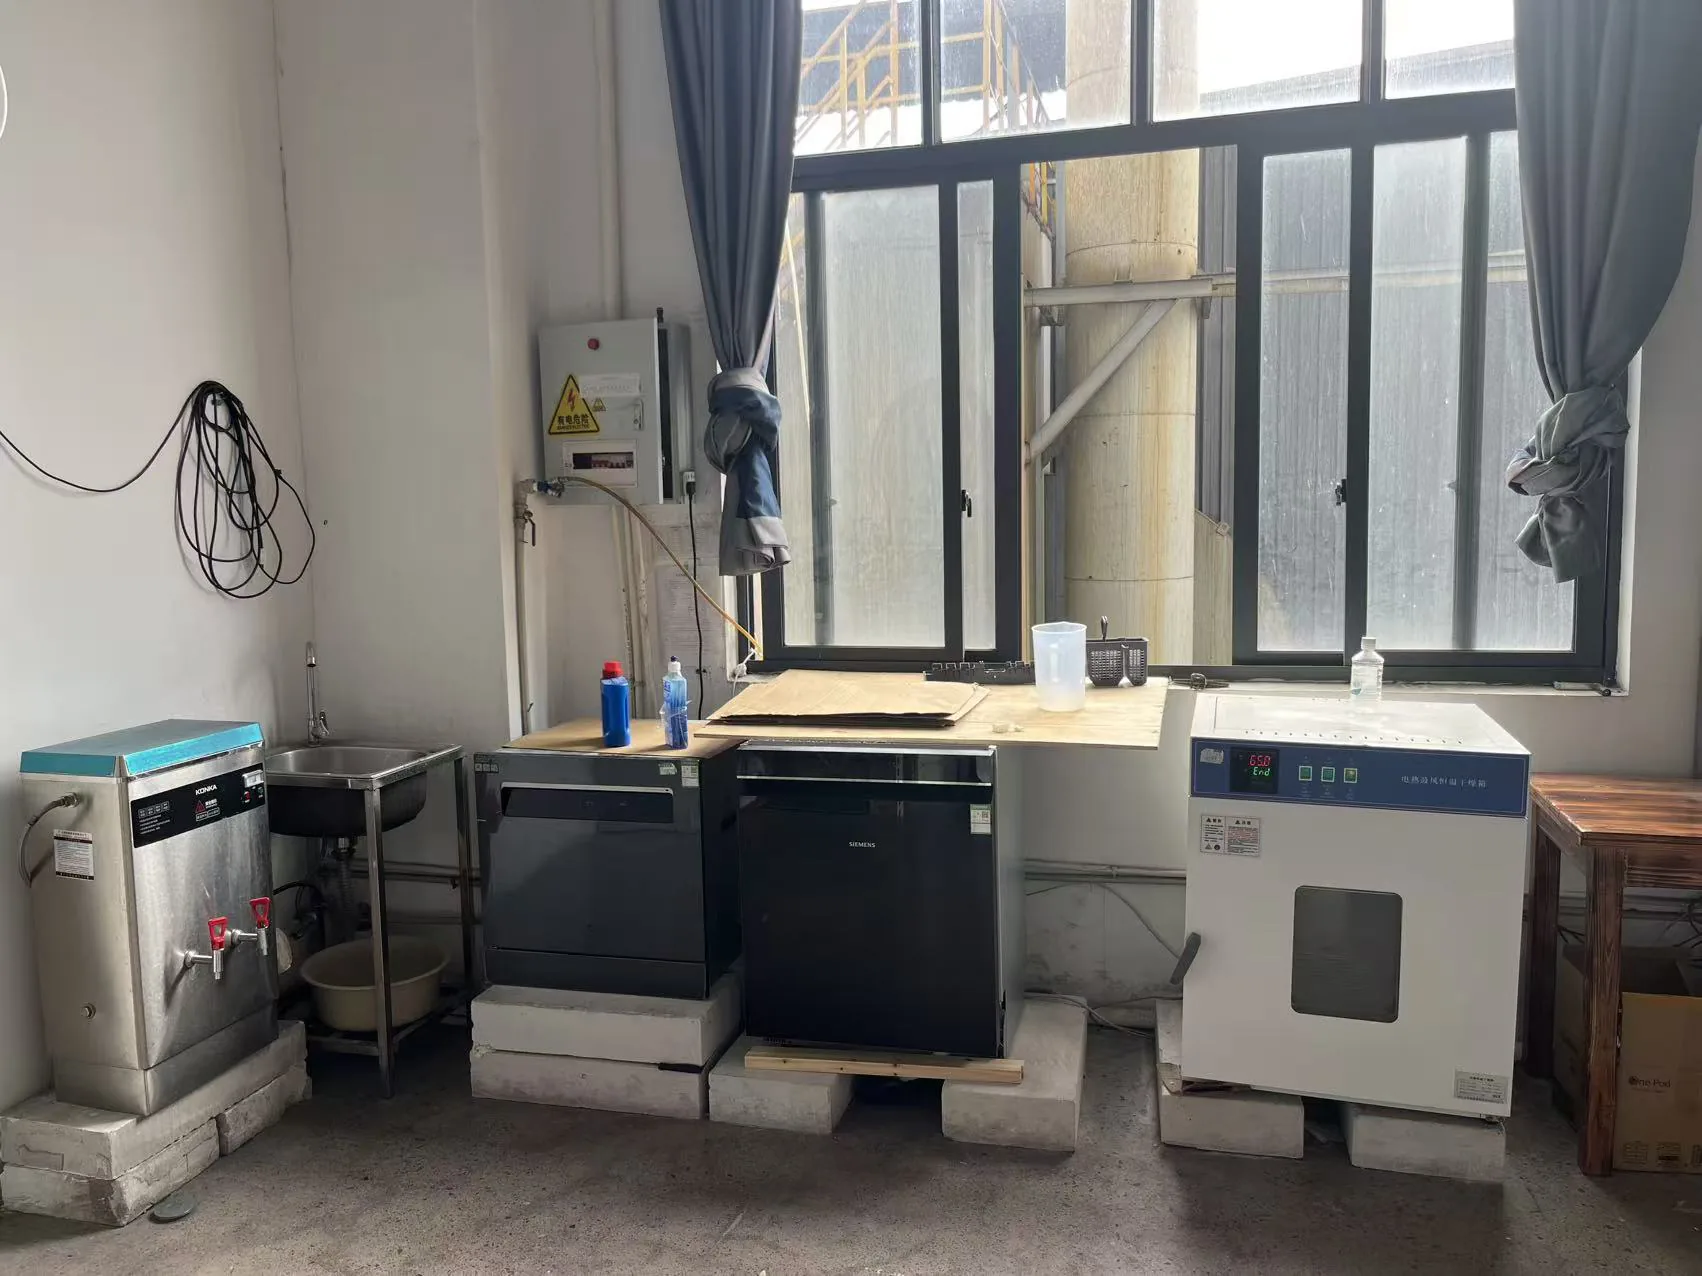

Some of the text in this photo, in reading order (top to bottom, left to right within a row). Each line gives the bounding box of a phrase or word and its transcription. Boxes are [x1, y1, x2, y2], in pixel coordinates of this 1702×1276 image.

[557, 413, 590, 425] 有电危险
[1252, 766, 1271, 777] End
[195, 784, 218, 796] KONKA
